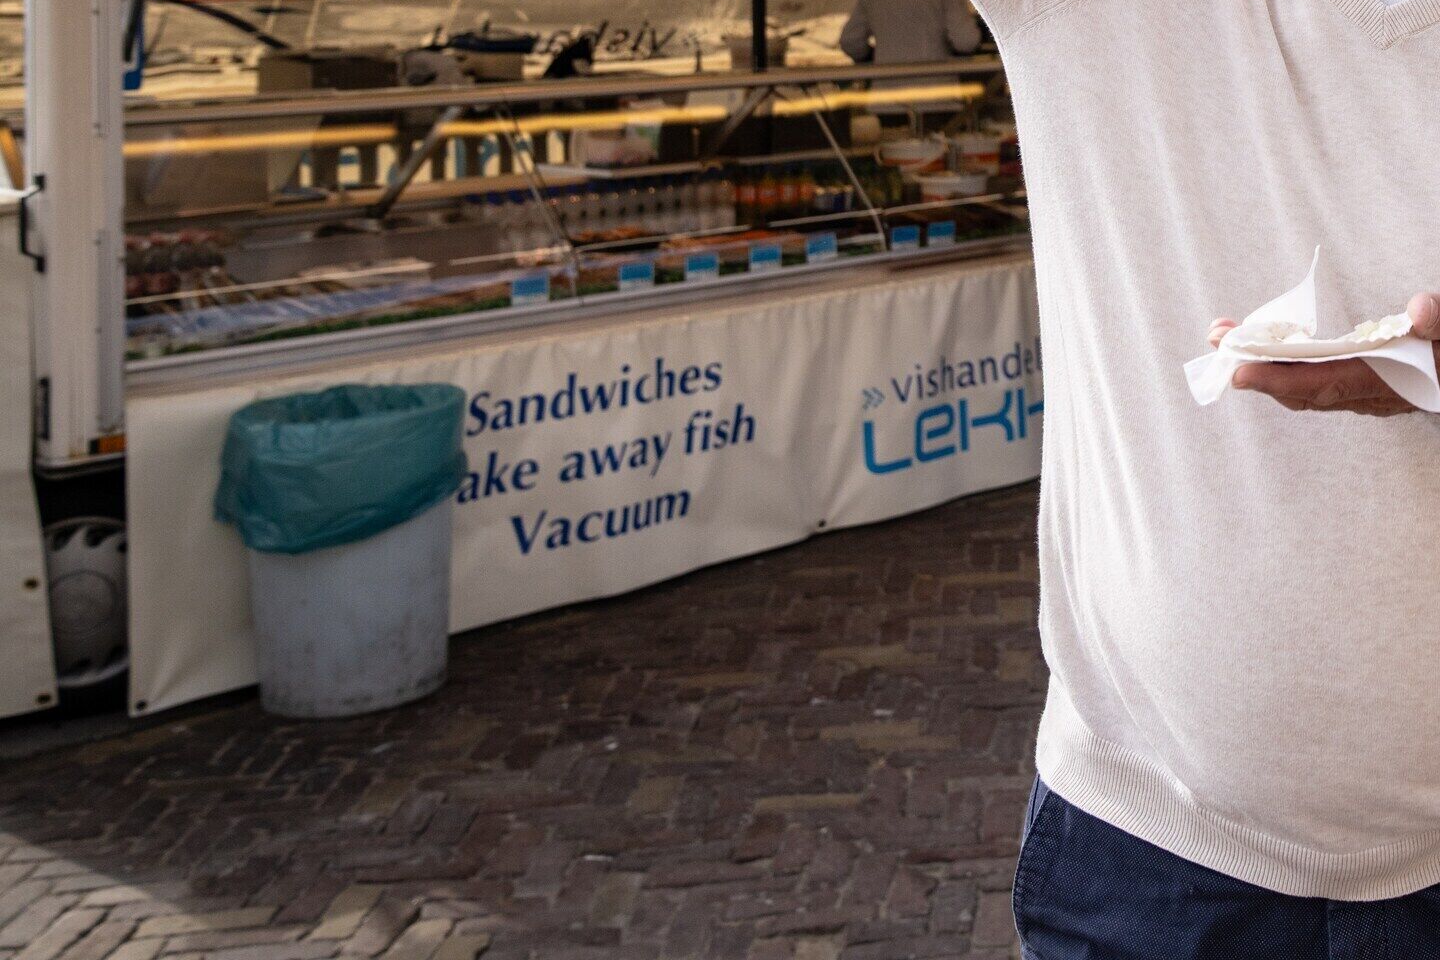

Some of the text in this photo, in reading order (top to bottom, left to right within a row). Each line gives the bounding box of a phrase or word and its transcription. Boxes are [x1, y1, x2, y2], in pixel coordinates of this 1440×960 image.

[466, 356, 723, 437] Sandwiches
[456, 402, 756, 504] ake away fish
[510, 489, 691, 555] Vacuum
